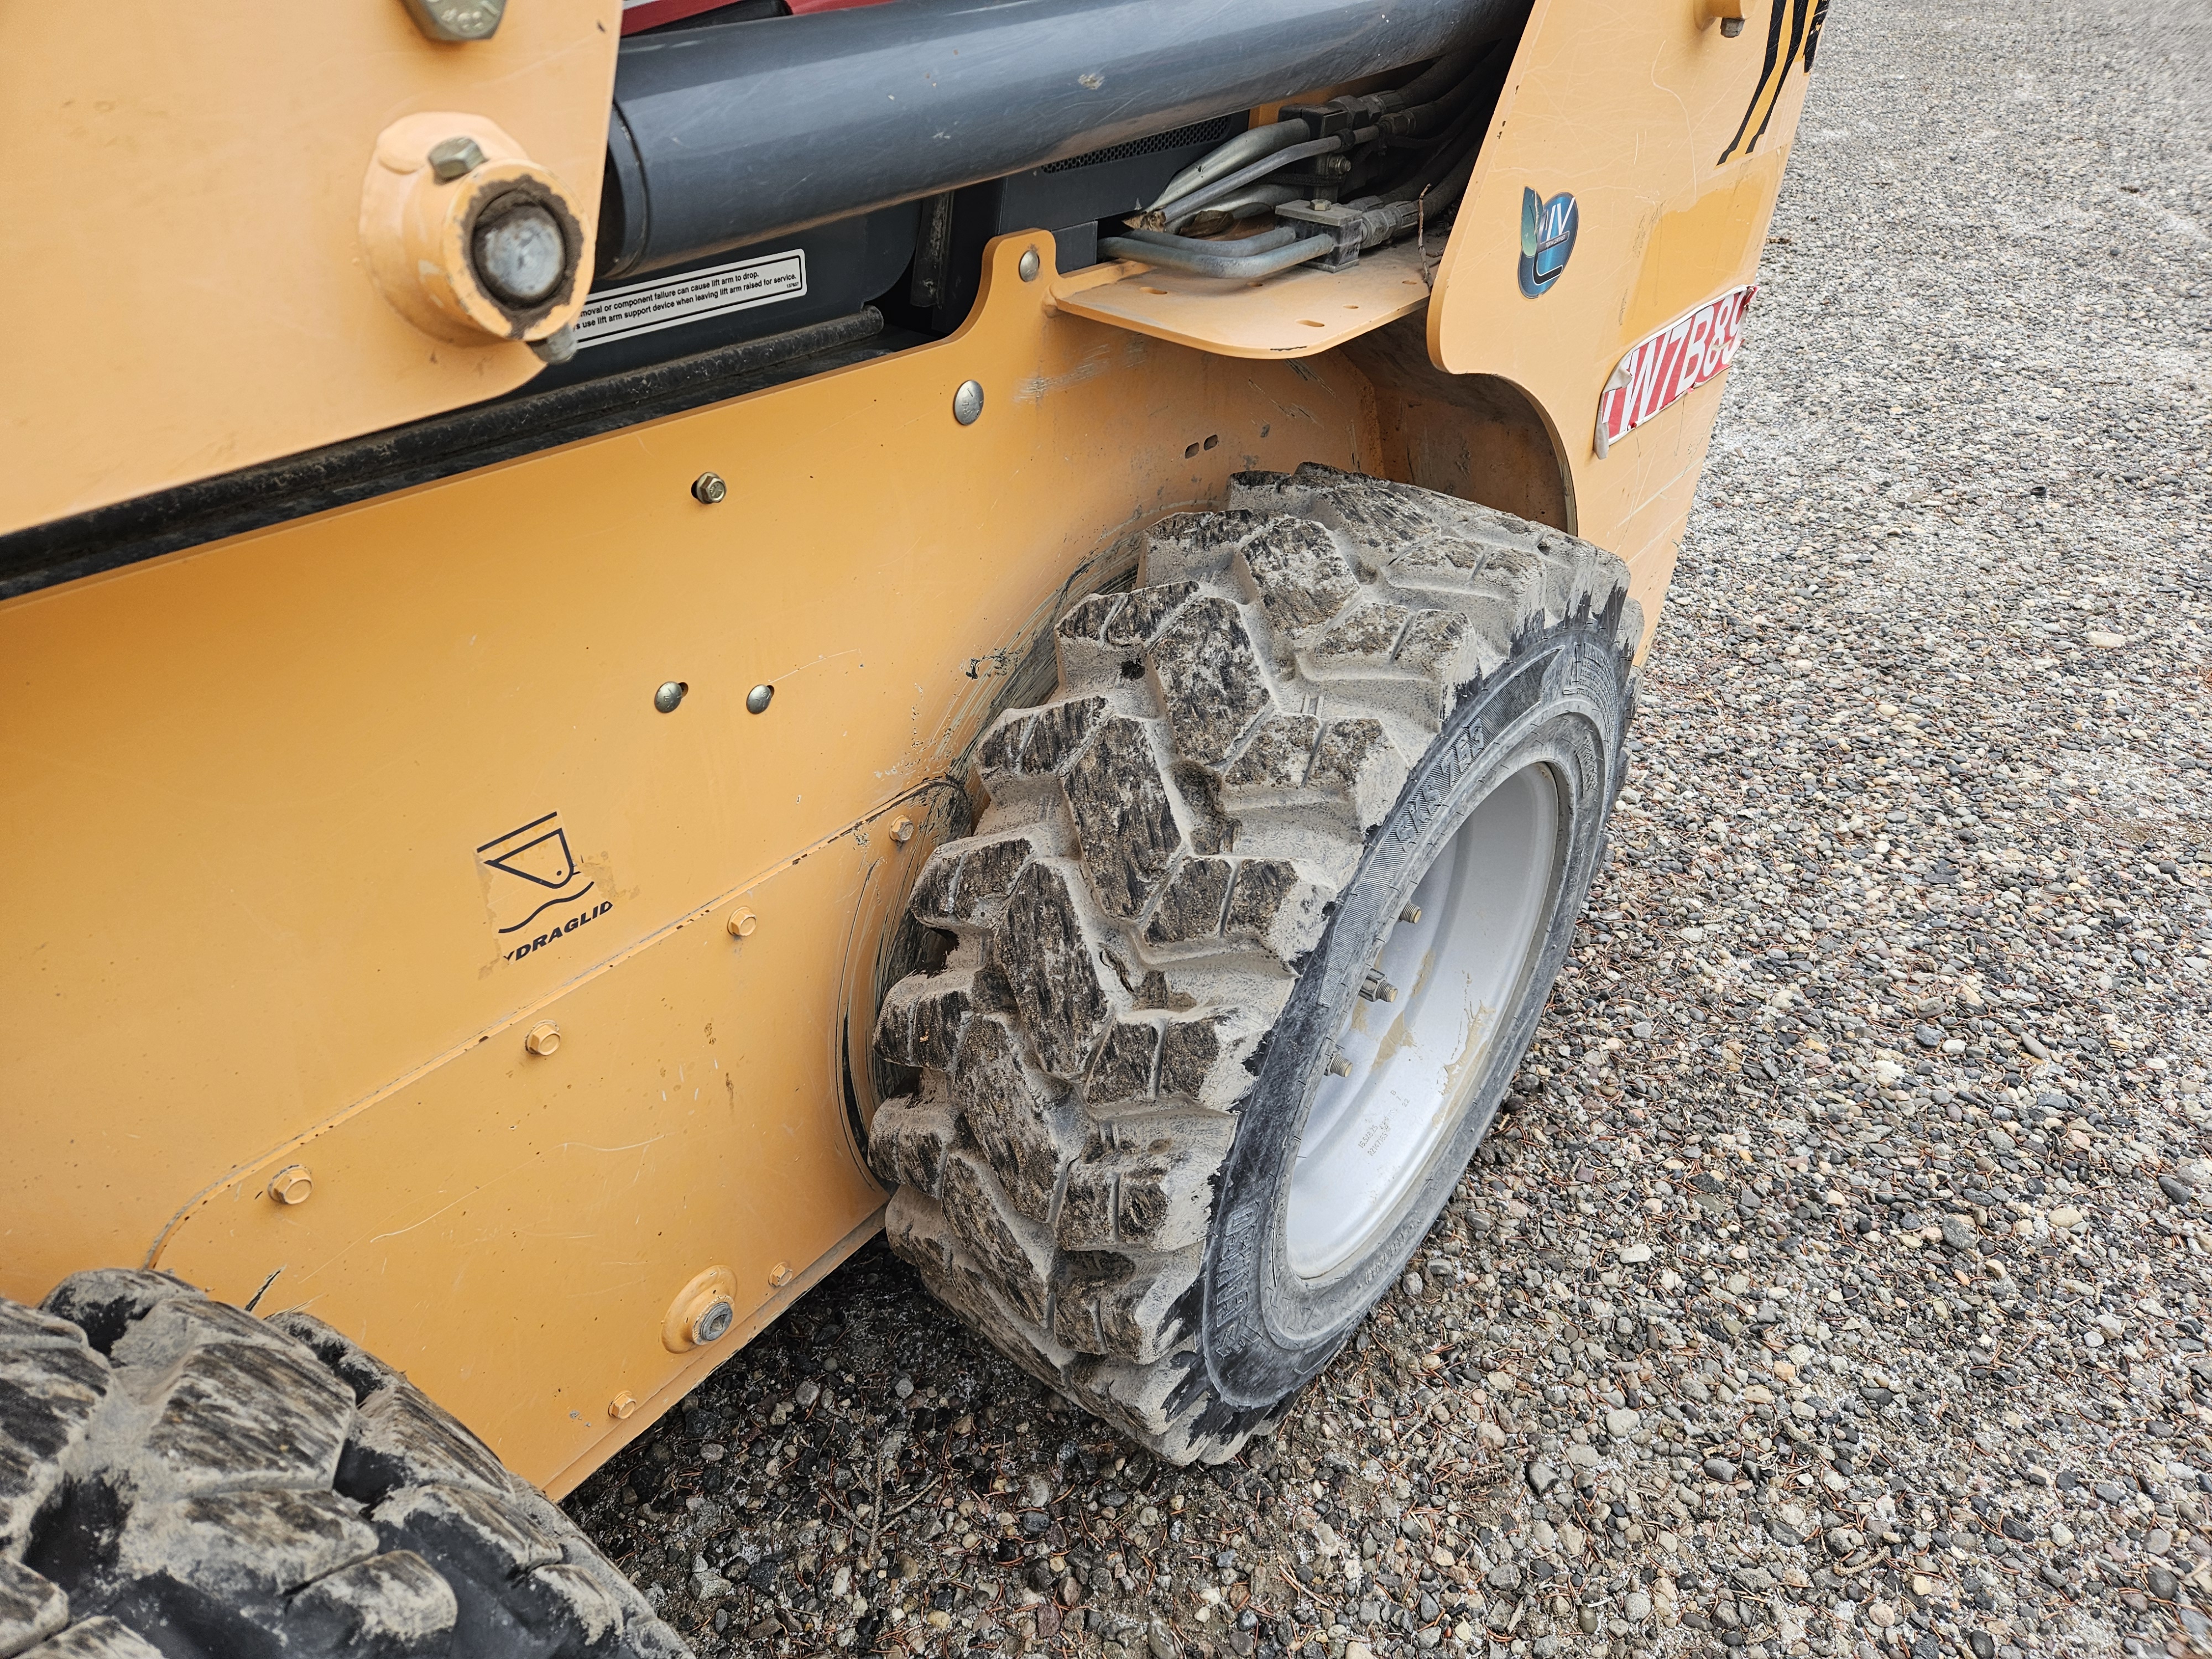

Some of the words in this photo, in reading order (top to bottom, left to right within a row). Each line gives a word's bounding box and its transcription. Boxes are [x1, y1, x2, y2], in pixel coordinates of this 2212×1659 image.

[582, 320, 596, 329] use
[597, 315, 607, 325] lift
[608, 313, 623, 322] arm
[624, 305, 651, 319] support
[653, 301, 675, 312] device
[676, 295, 694, 306] when
[695, 290, 718, 302] leaving
[720, 286, 728, 296] lift
[729, 285, 742, 294] arm
[743, 280, 762, 290] raised
[763, 278, 773, 286] for
[774, 273, 796, 284] service.
[614, 294, 653, 309] component
[654, 290, 676, 301] failure
[677, 286, 689, 295] can
[691, 281, 710, 291] cause
[711, 278, 720, 287] lift
[721, 276, 734, 285] arm
[743, 271, 759, 281] drop.
